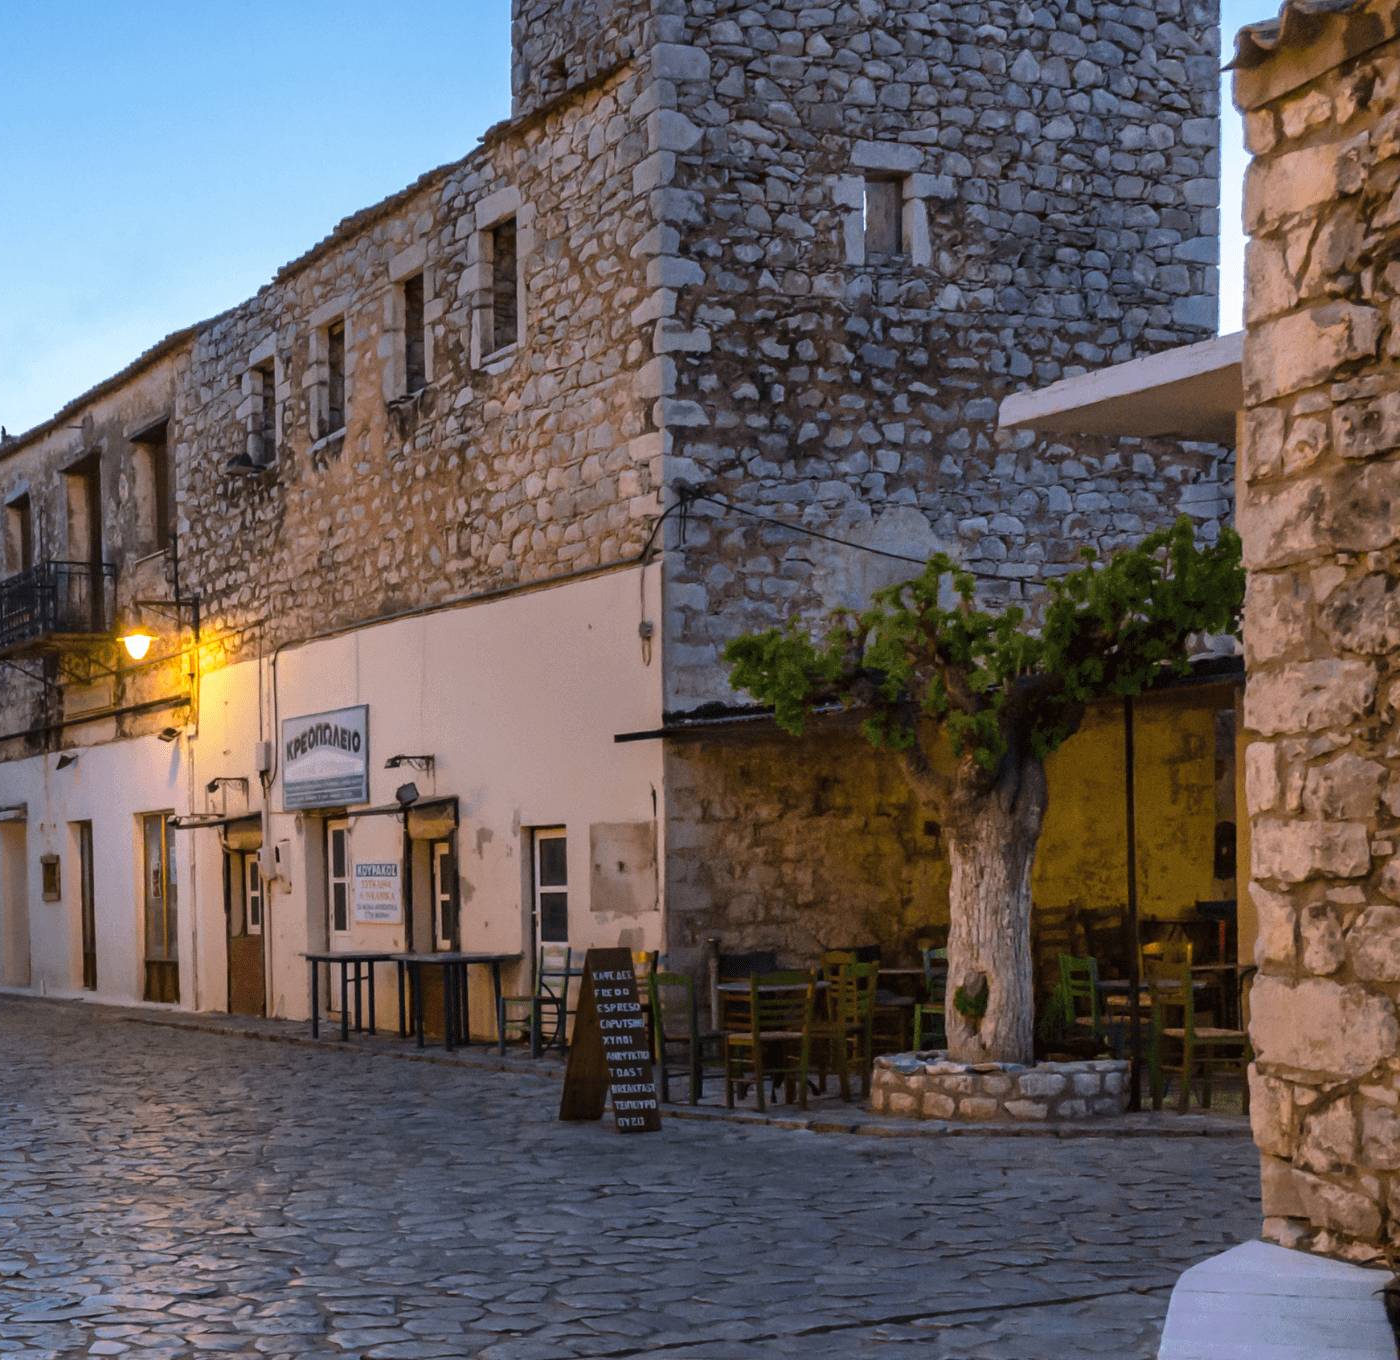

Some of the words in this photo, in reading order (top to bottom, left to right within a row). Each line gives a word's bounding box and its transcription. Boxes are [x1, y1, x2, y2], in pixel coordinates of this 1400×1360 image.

[286, 722, 361, 761] ΚΡΕΟΠΩΛΕΙΟ
[596, 1003, 641, 1013] ESPRESO
[608, 1067, 643, 1078] TOAST
[611, 1083, 656, 1094] BREAKFAST
